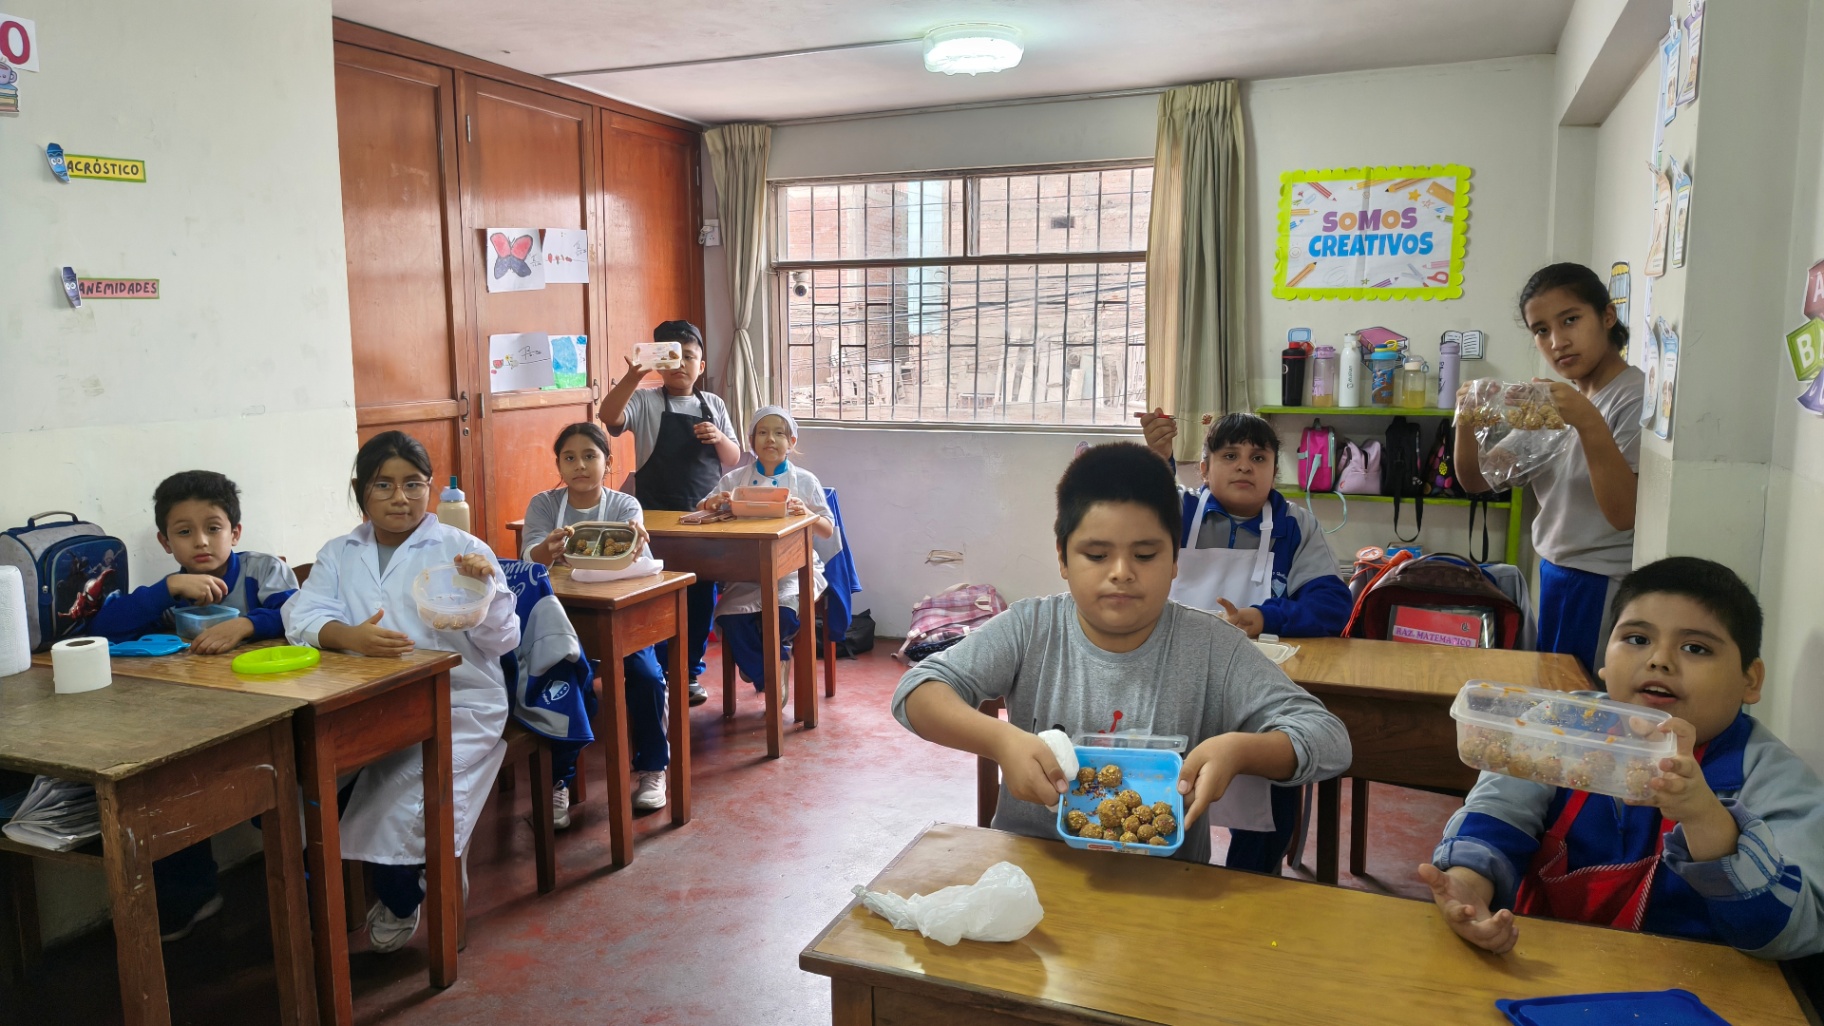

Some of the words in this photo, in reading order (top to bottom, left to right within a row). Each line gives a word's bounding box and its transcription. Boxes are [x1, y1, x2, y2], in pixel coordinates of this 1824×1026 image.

[67, 158, 140, 177] ACRÓSTICO
[1322, 207, 1418, 233] SOMOS
[1308, 231, 1434, 257] CREATIVOS
[79, 280, 158, 296] ANEMIDADES
[1796, 333, 1815, 369] B
